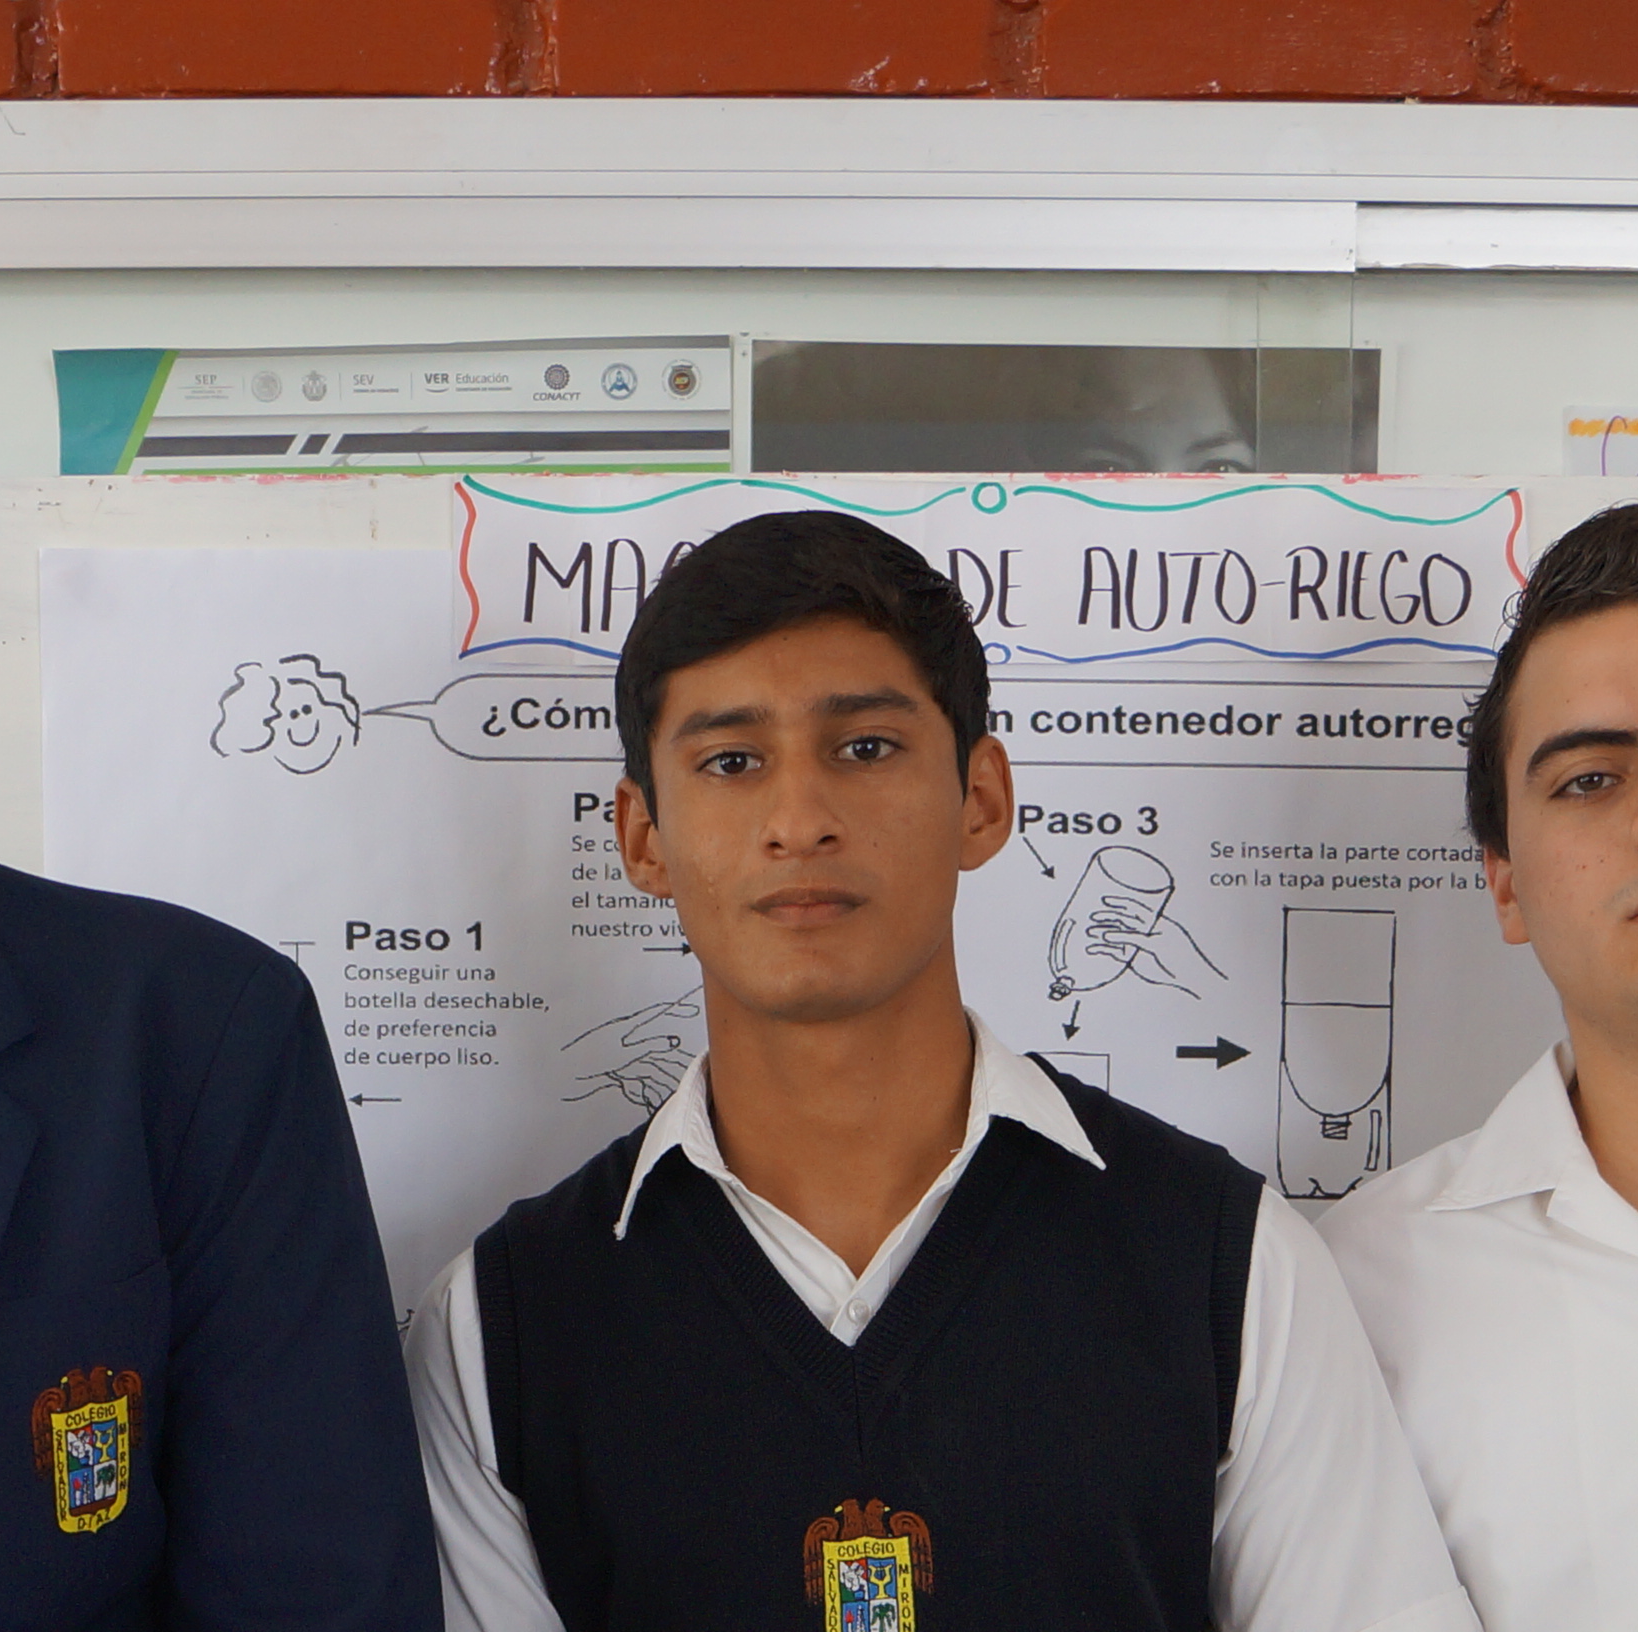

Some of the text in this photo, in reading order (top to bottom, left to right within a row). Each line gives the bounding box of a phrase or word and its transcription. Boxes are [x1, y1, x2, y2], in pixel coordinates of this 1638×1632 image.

[194, 374, 217, 385] SEP
[352, 374, 375, 386] SEV
[423, 371, 509, 385] VER Educación
[532, 391, 581, 402] CONACYT
[482, 697, 612, 738] ¿Cóm
[1029, 705, 1284, 739] contenedor
[1295, 711, 1475, 749] autorreg
[573, 791, 616, 823] Pa
[1017, 804, 1160, 836] Paso 3
[571, 834, 597, 852] Se
[1209, 840, 1485, 866] Se inserta la parte cortada
[571, 862, 623, 881] de la
[1209, 870, 1248, 888] con
[1253, 869, 1272, 888] la
[1277, 872, 1325, 893] tapa
[1330, 872, 1402, 893] puesta
[1407, 875, 1444, 893] por
[1450, 871, 1468, 890] la
[571, 890, 590, 909] el
[344, 919, 484, 952] Paso 1
[571, 920, 653, 938] nuestro
[343, 963, 497, 985] Conseguir una
[343, 991, 551, 1013] botella desechable,
[343, 1020, 498, 1041] de preferencia
[343, 1047, 500, 1070] de cuerpo liso.
[64, 1403, 117, 1428] COLEGIO
[117, 1422, 127, 1491] MIRON
[53, 1429, 68, 1522] SALVADOR
[77, 1507, 112, 1531] DIAZ
[837, 1541, 896, 1558] COLEGIO
